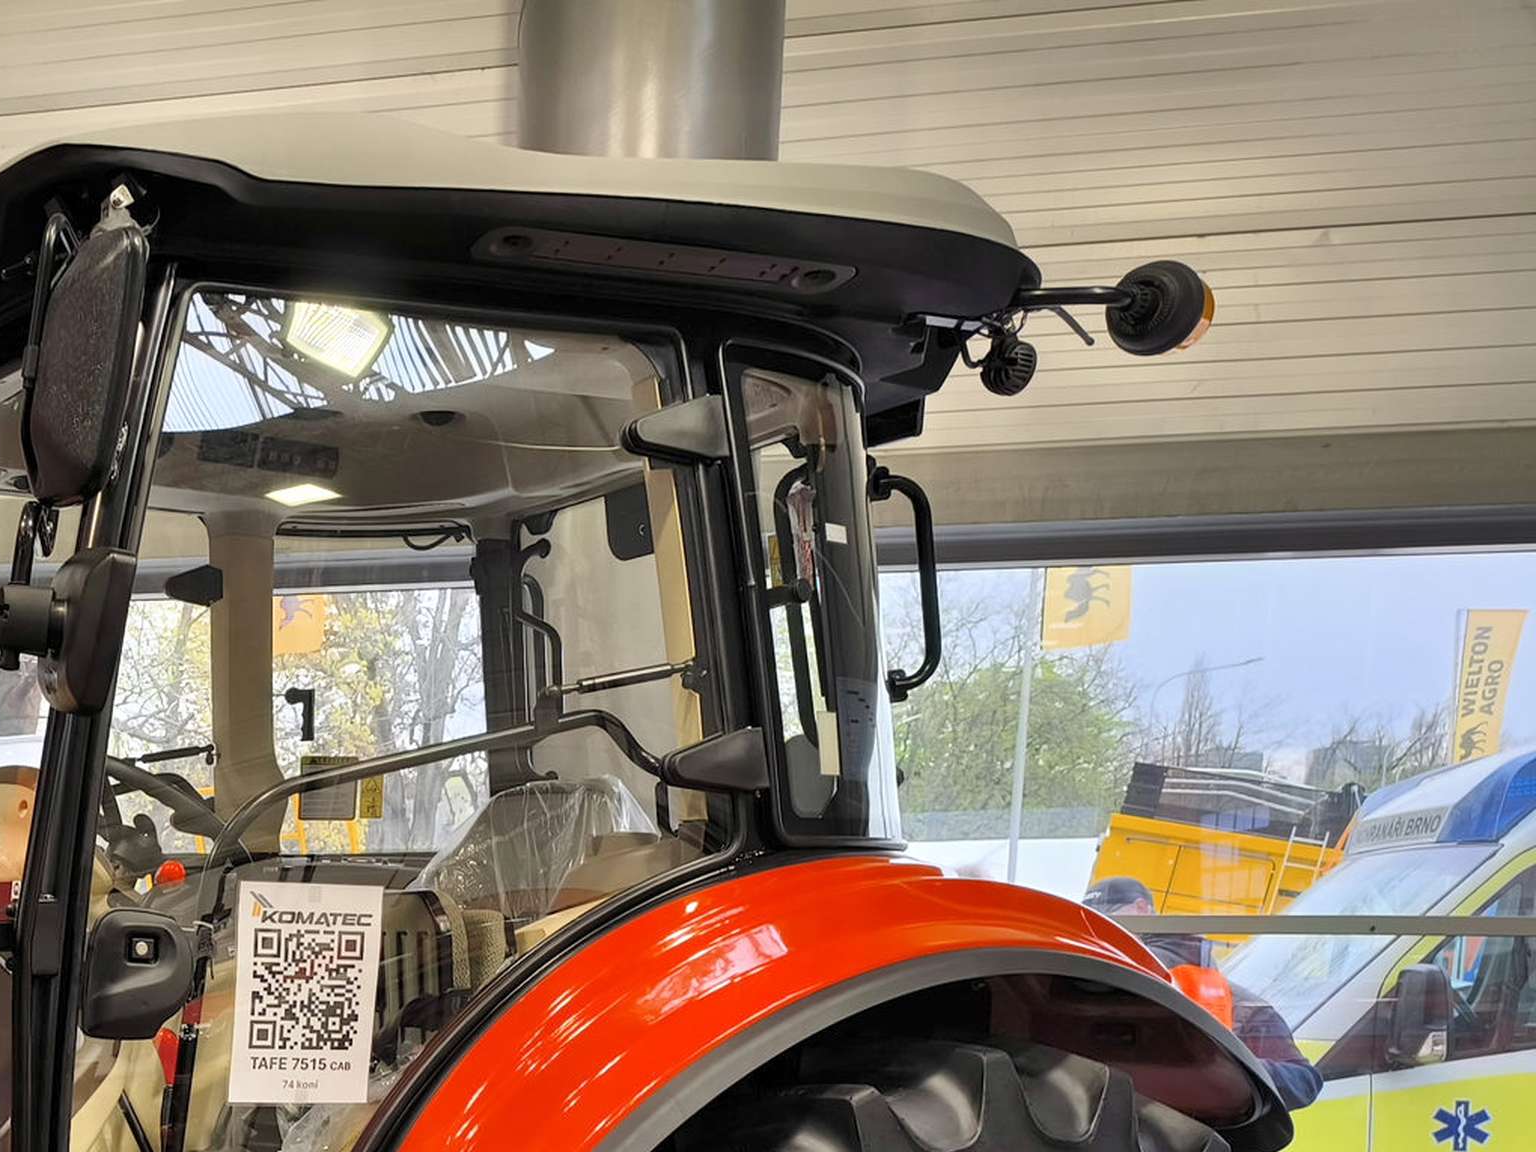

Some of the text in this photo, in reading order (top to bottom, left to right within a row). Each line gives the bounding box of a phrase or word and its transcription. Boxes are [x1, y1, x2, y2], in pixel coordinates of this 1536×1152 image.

[1461, 626, 1493, 717] WIELTON
[1480, 659, 1504, 715] AGRO
[1404, 814, 1441, 836] BRNO
[261, 910, 373, 927] KOMATEC
[250, 1057, 351, 1071] TAFE 7515 CAB
[282, 1080, 294, 1090] 74
